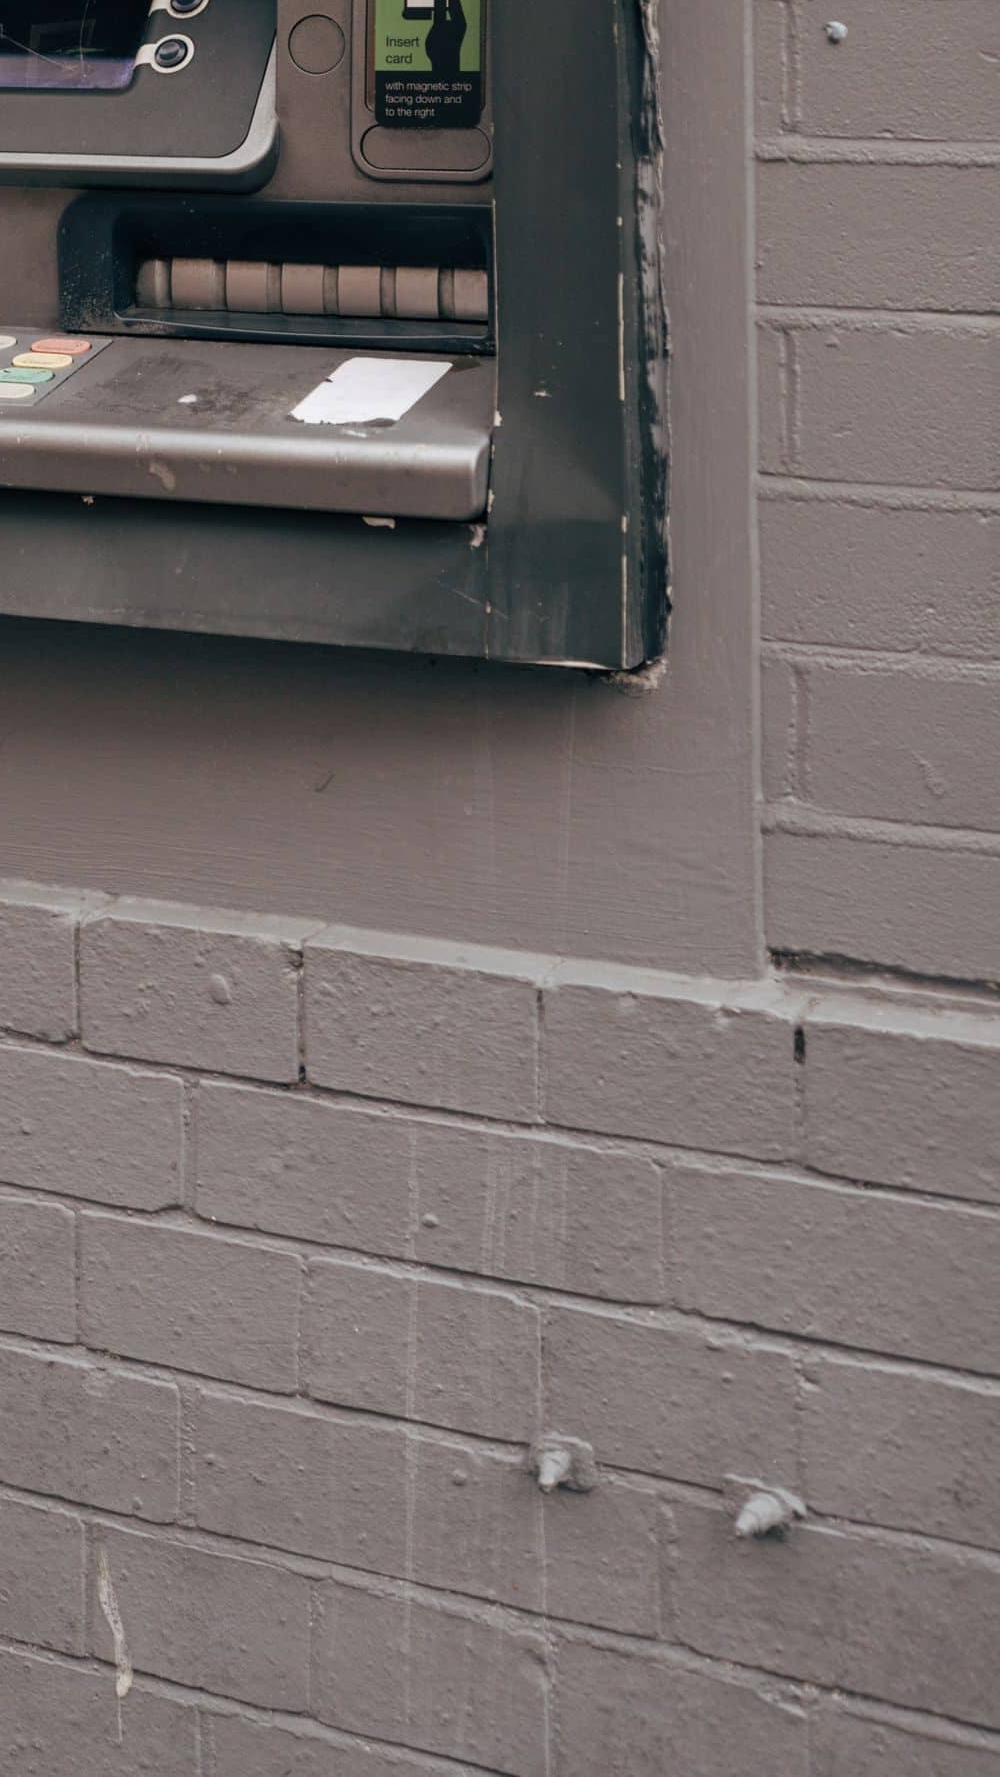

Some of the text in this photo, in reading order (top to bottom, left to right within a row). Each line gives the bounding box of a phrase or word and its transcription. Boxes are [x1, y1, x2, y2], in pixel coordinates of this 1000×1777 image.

[385, 36, 420, 48] Insert
[385, 52, 413, 64] card
[385, 81, 473, 93] with magnetic strip
[385, 94, 462, 105] facing down and
[385, 107, 436, 119] to the right
